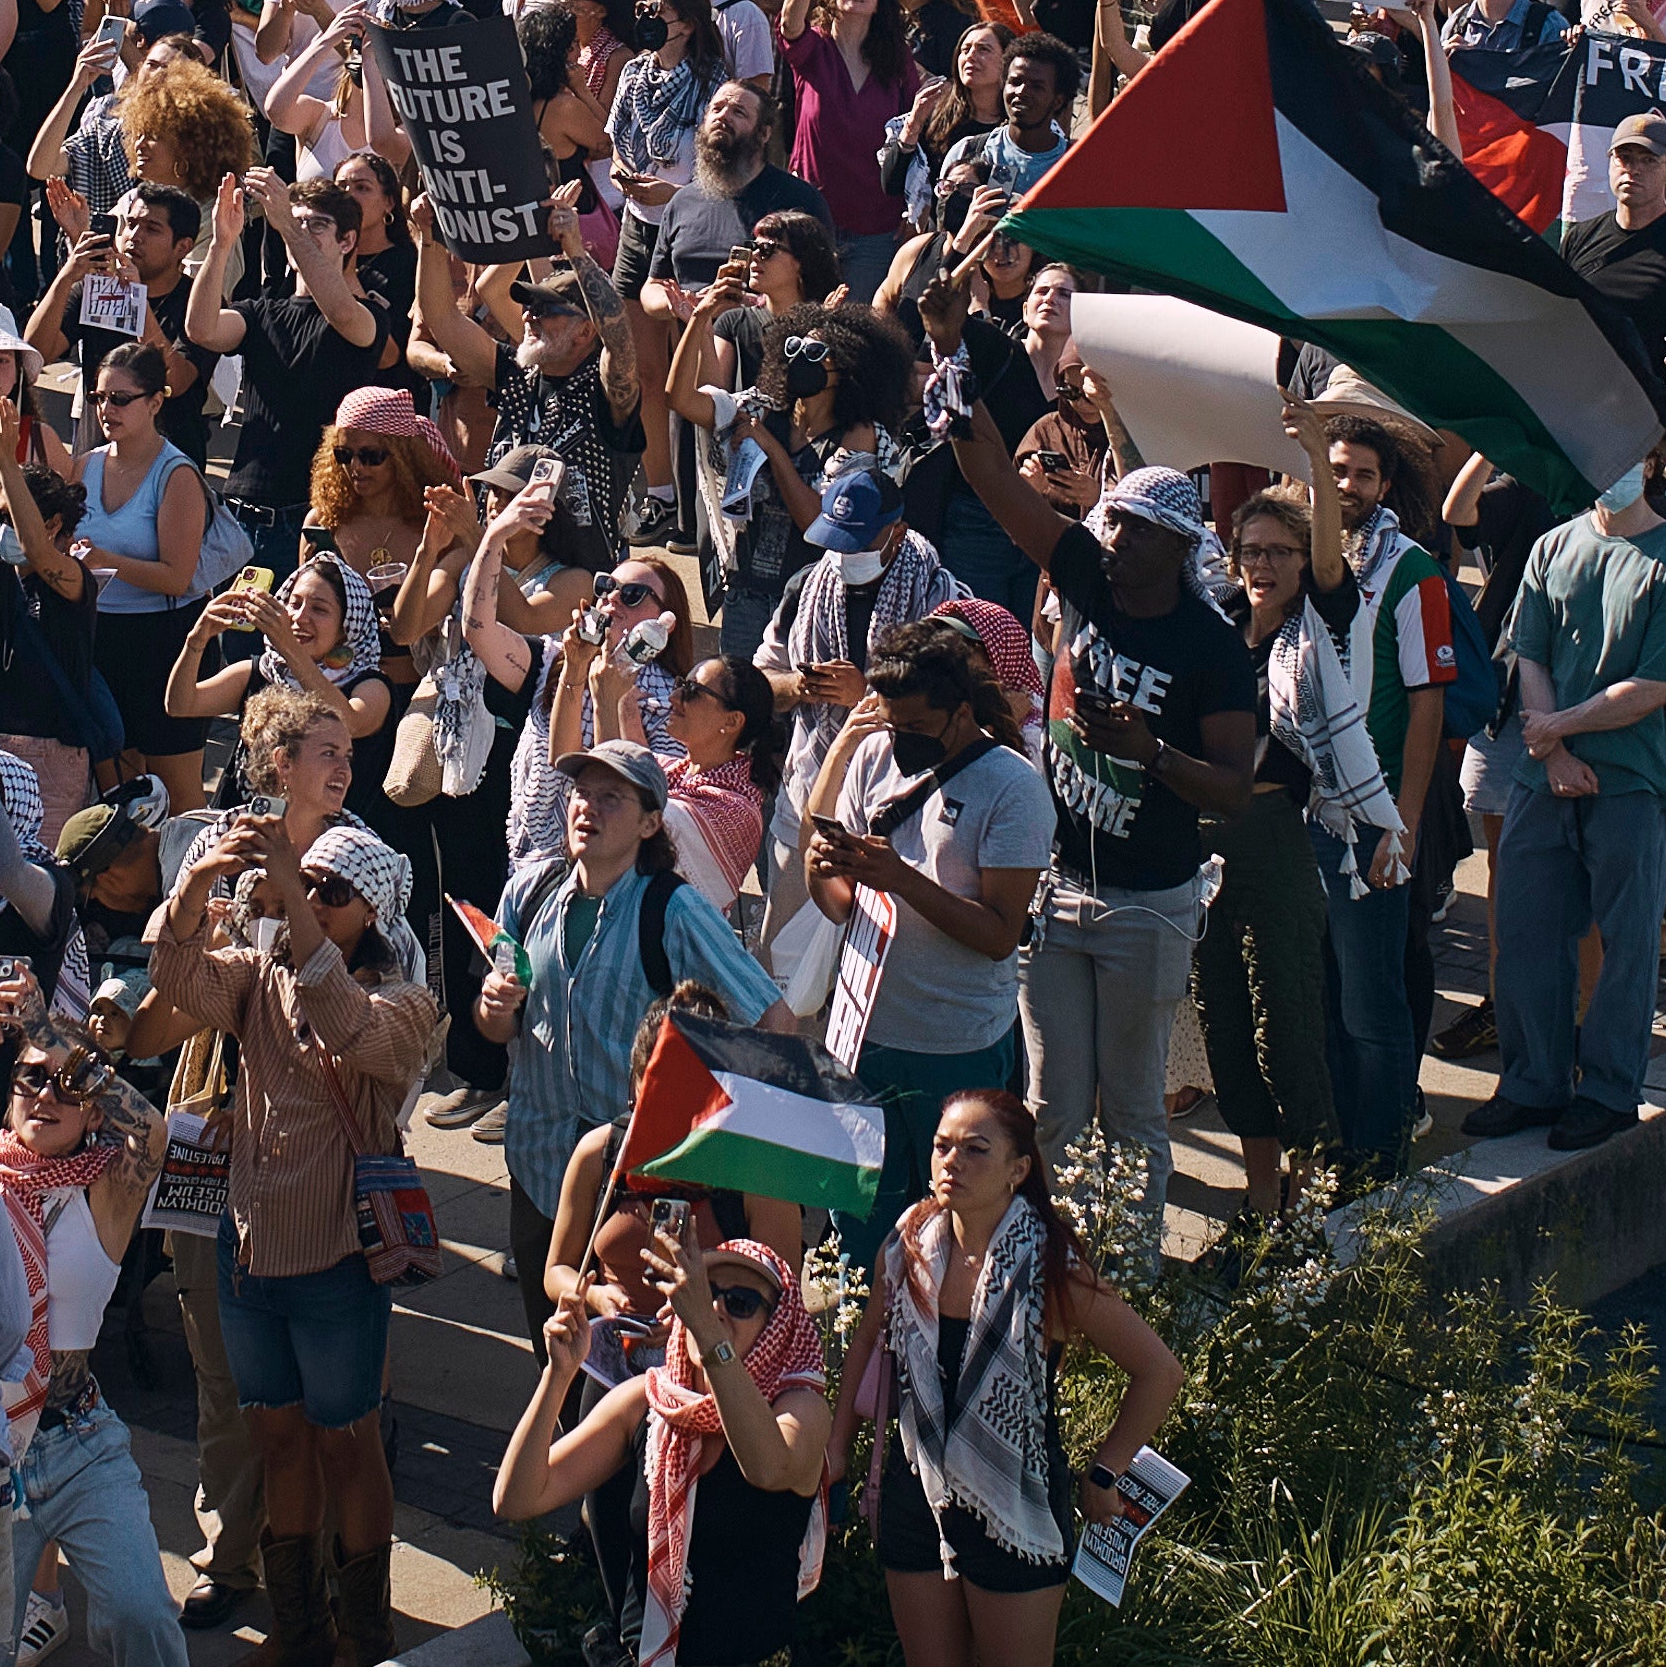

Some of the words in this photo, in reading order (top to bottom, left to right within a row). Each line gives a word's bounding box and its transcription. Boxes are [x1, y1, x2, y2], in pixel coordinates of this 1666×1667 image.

[393, 45, 468, 83] THE
[387, 79, 516, 124] FUTURE
[429, 129, 466, 164] IS
[422, 163, 507, 204] ANTI-
[438, 201, 540, 244] ONIST
[157, 1196, 223, 1214] OOKLYN
[168, 1186, 227, 1202] USEUM
